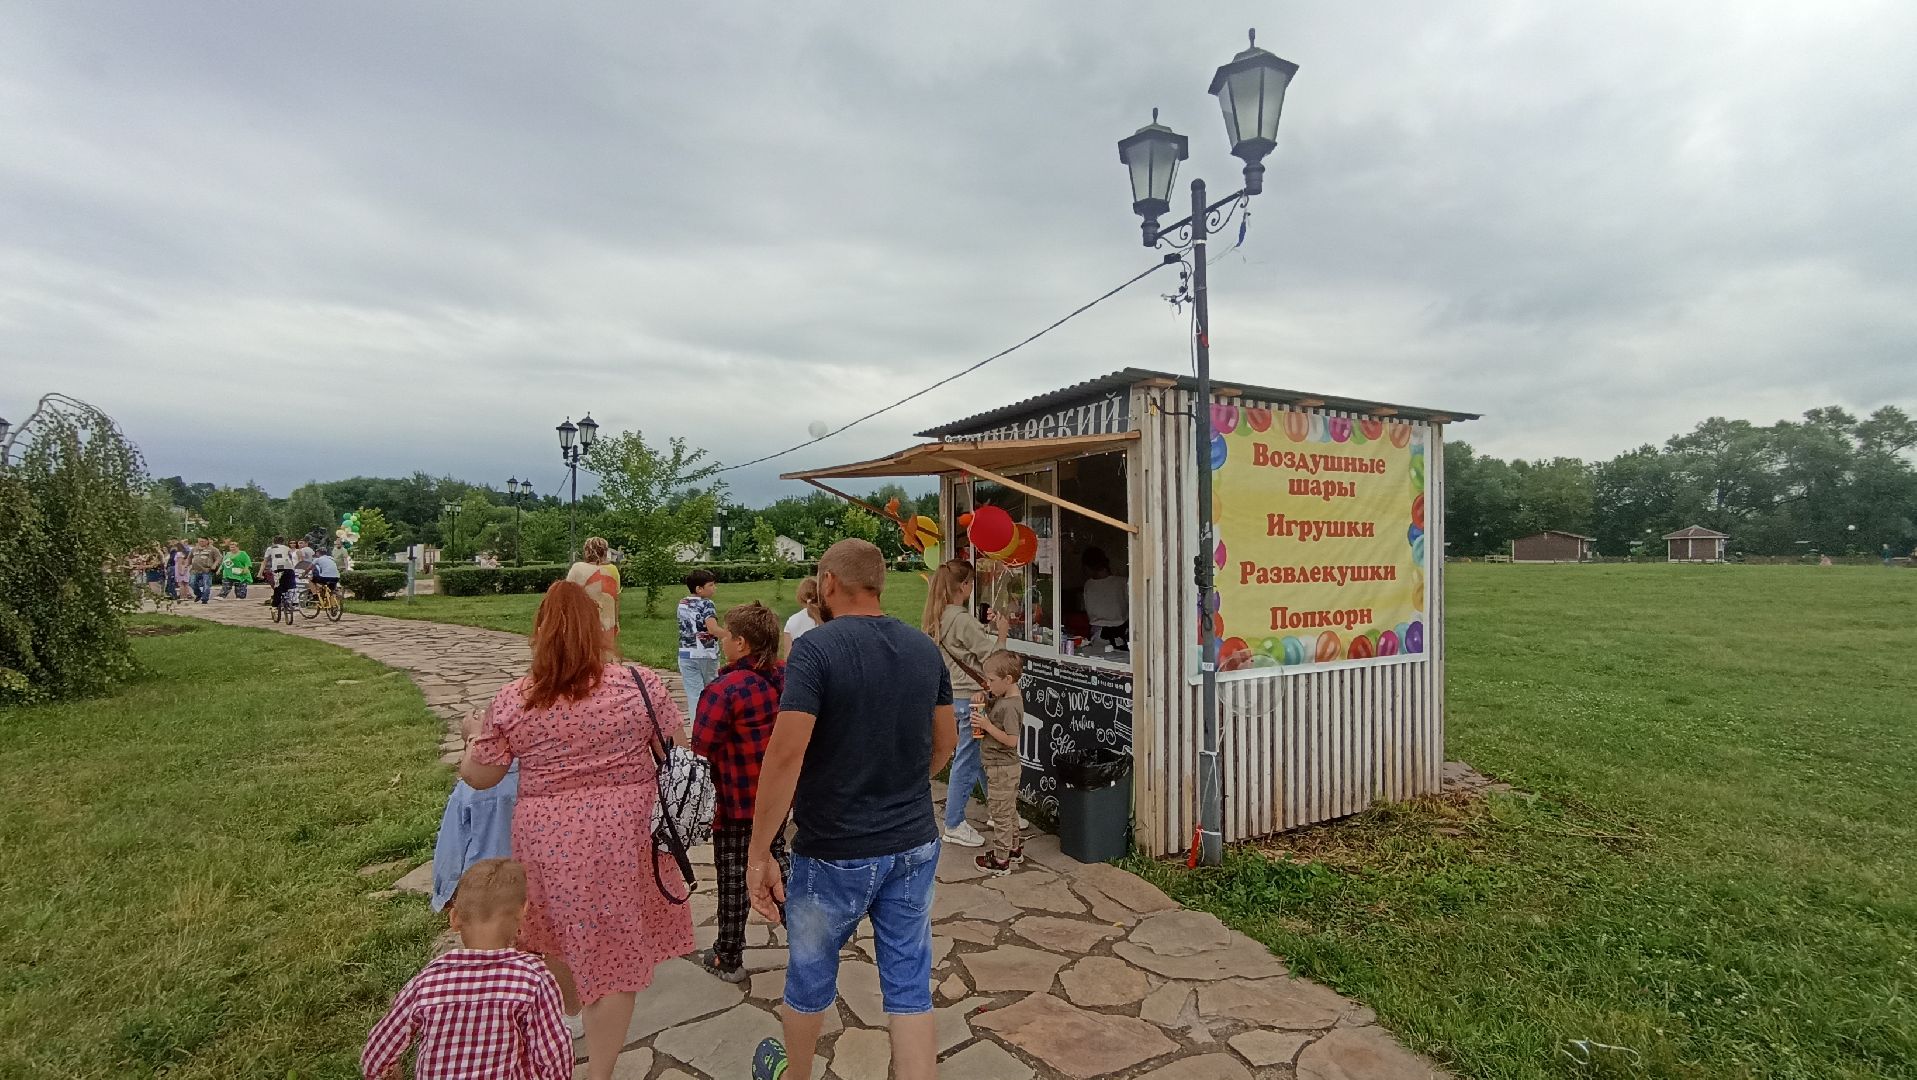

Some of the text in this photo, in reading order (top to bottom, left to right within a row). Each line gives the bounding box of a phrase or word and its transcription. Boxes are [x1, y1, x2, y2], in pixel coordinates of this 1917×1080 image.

[1252, 442, 1386, 475] Воздушные
[1288, 477, 1356, 501] шары
[1266, 513, 1375, 541] Игрушки
[1239, 561, 1397, 586] Развлекушки
[1270, 606, 1373, 630] Попкорн
[1068, 689, 1090, 711] 100%
